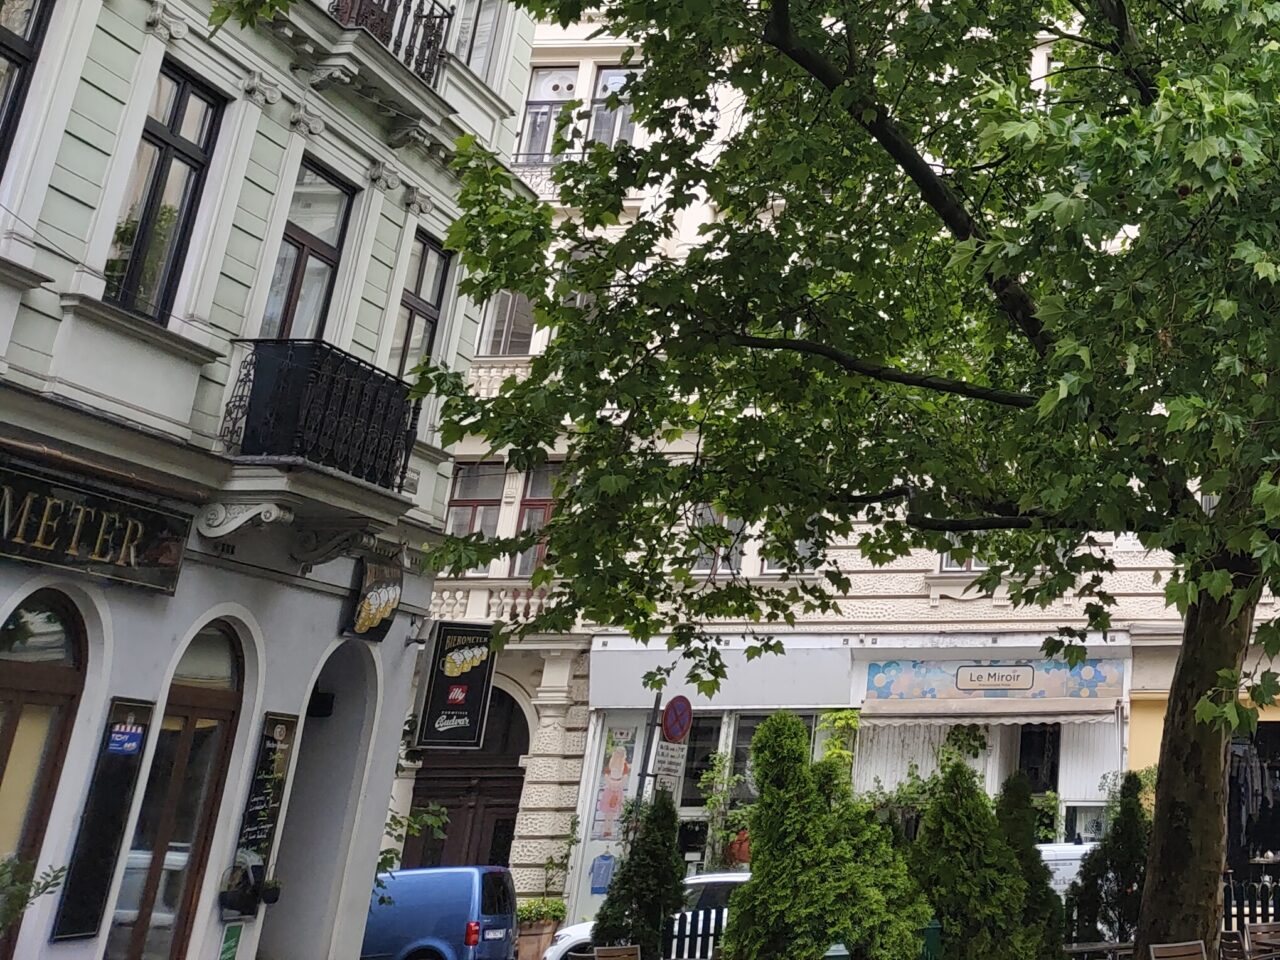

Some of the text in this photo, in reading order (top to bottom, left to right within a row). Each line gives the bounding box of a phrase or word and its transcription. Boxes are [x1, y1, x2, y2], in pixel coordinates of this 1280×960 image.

[0, 486, 144, 570] METER
[445, 635, 488, 651] BIEROMETER
[969, 671, 1021, 682] Le Miroir
[448, 688, 466, 702] illy
